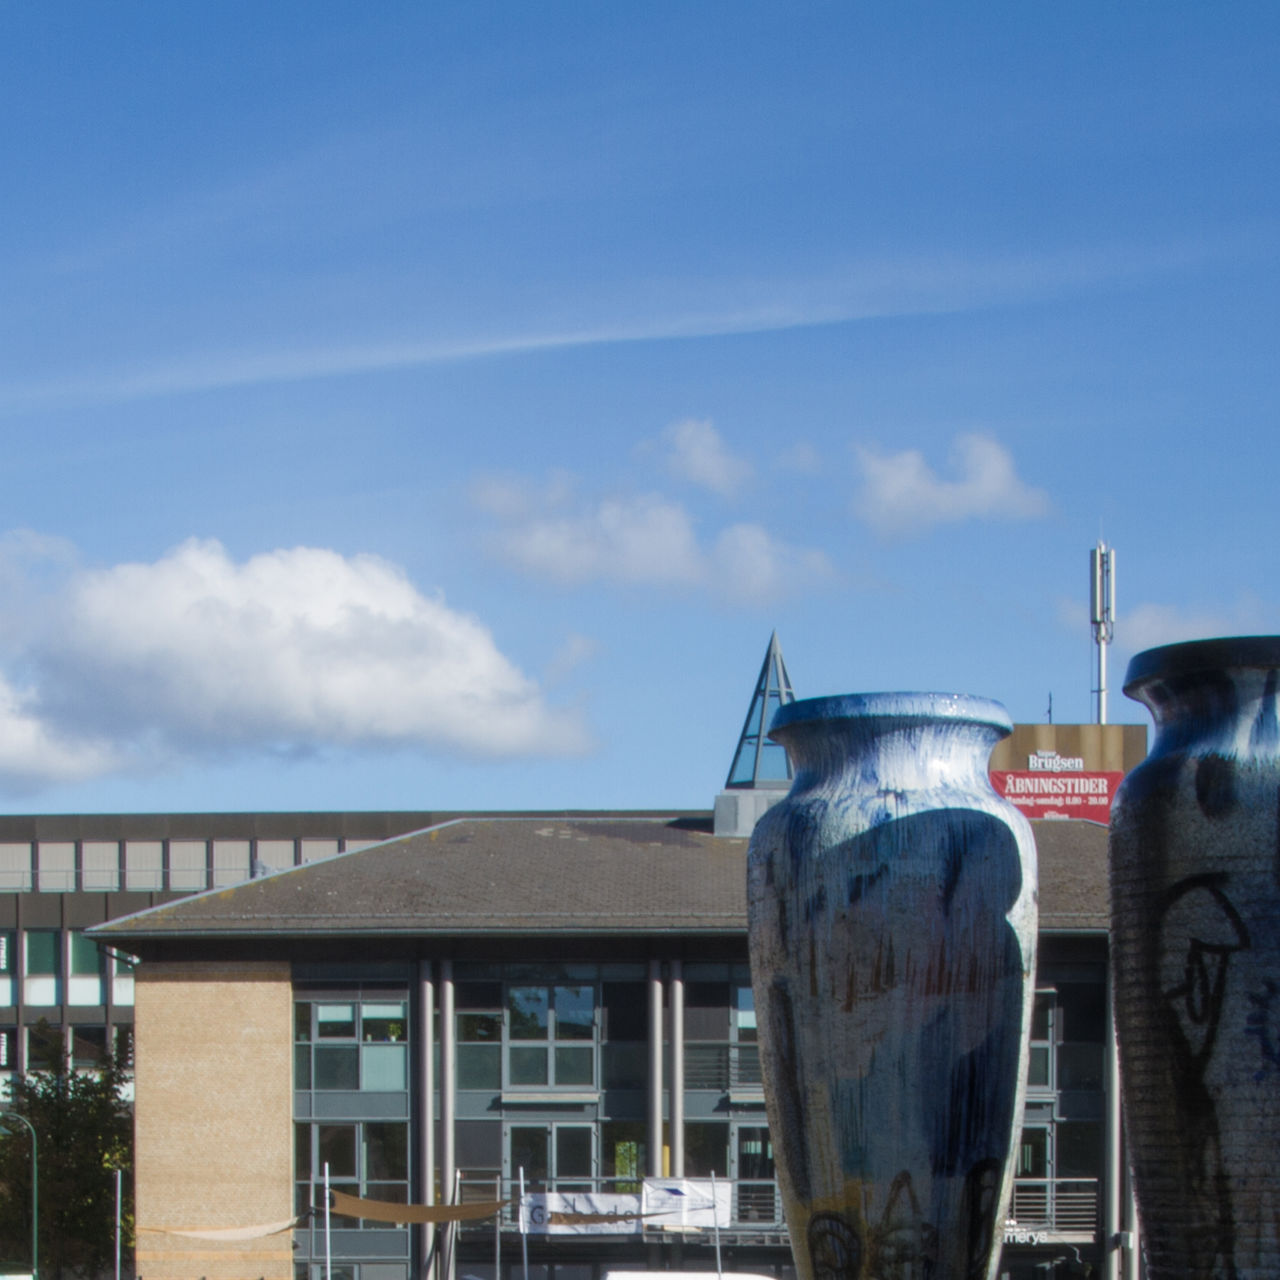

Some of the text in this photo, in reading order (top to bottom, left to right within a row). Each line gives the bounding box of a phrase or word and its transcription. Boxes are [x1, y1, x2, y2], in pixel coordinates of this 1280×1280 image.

[1028, 754, 1084, 773] Brugsen
[1004, 774, 1109, 795] ÅBNINGSTIDER
[1004, 1231, 1048, 1246] merys
